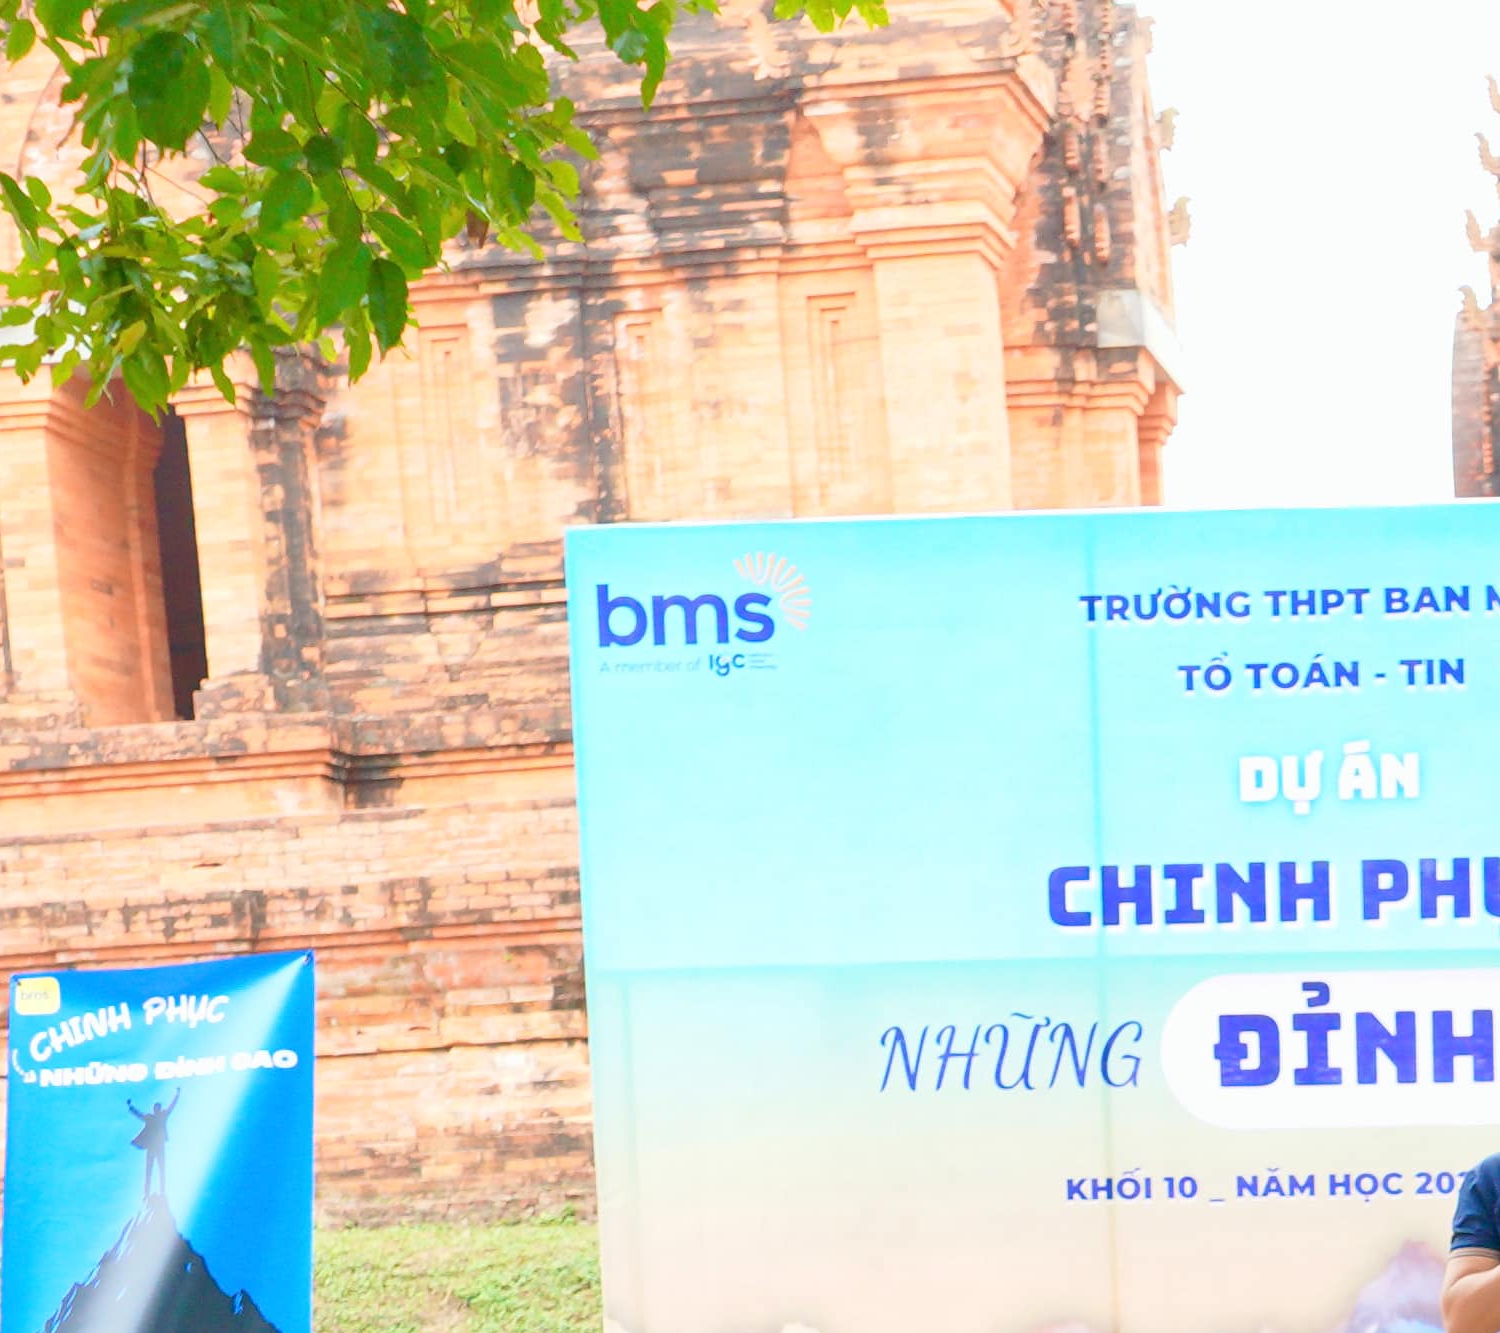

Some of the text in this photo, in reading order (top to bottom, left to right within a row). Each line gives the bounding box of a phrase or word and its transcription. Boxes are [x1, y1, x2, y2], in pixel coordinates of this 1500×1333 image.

[596, 583, 776, 648] bms
[1080, 585, 1251, 624] TRƯỜNG
[1263, 587, 1369, 618] THPT
[1383, 585, 1472, 615] BAN
[614, 658, 682, 673] member
[687, 657, 703, 672] of
[1178, 652, 1234, 692] TỔ
[1245, 650, 1360, 690] TOÁN
[1400, 657, 1466, 686] TIN
[1240, 740, 1420, 814] DỰ ÁN
[1047, 860, 1330, 927] CHINH
[29, 995, 230, 1062] CHINH PHỤC
[878, 1013, 1145, 1093] NHỮNG
[1212, 980, 1494, 1088] ĐỈNH
[1067, 1167, 1153, 1201] KHỐI
[1164, 1176, 1198, 1199] 10
[1236, 1167, 1316, 1198] NĂM
[1329, 1173, 1404, 1203] HỌC
